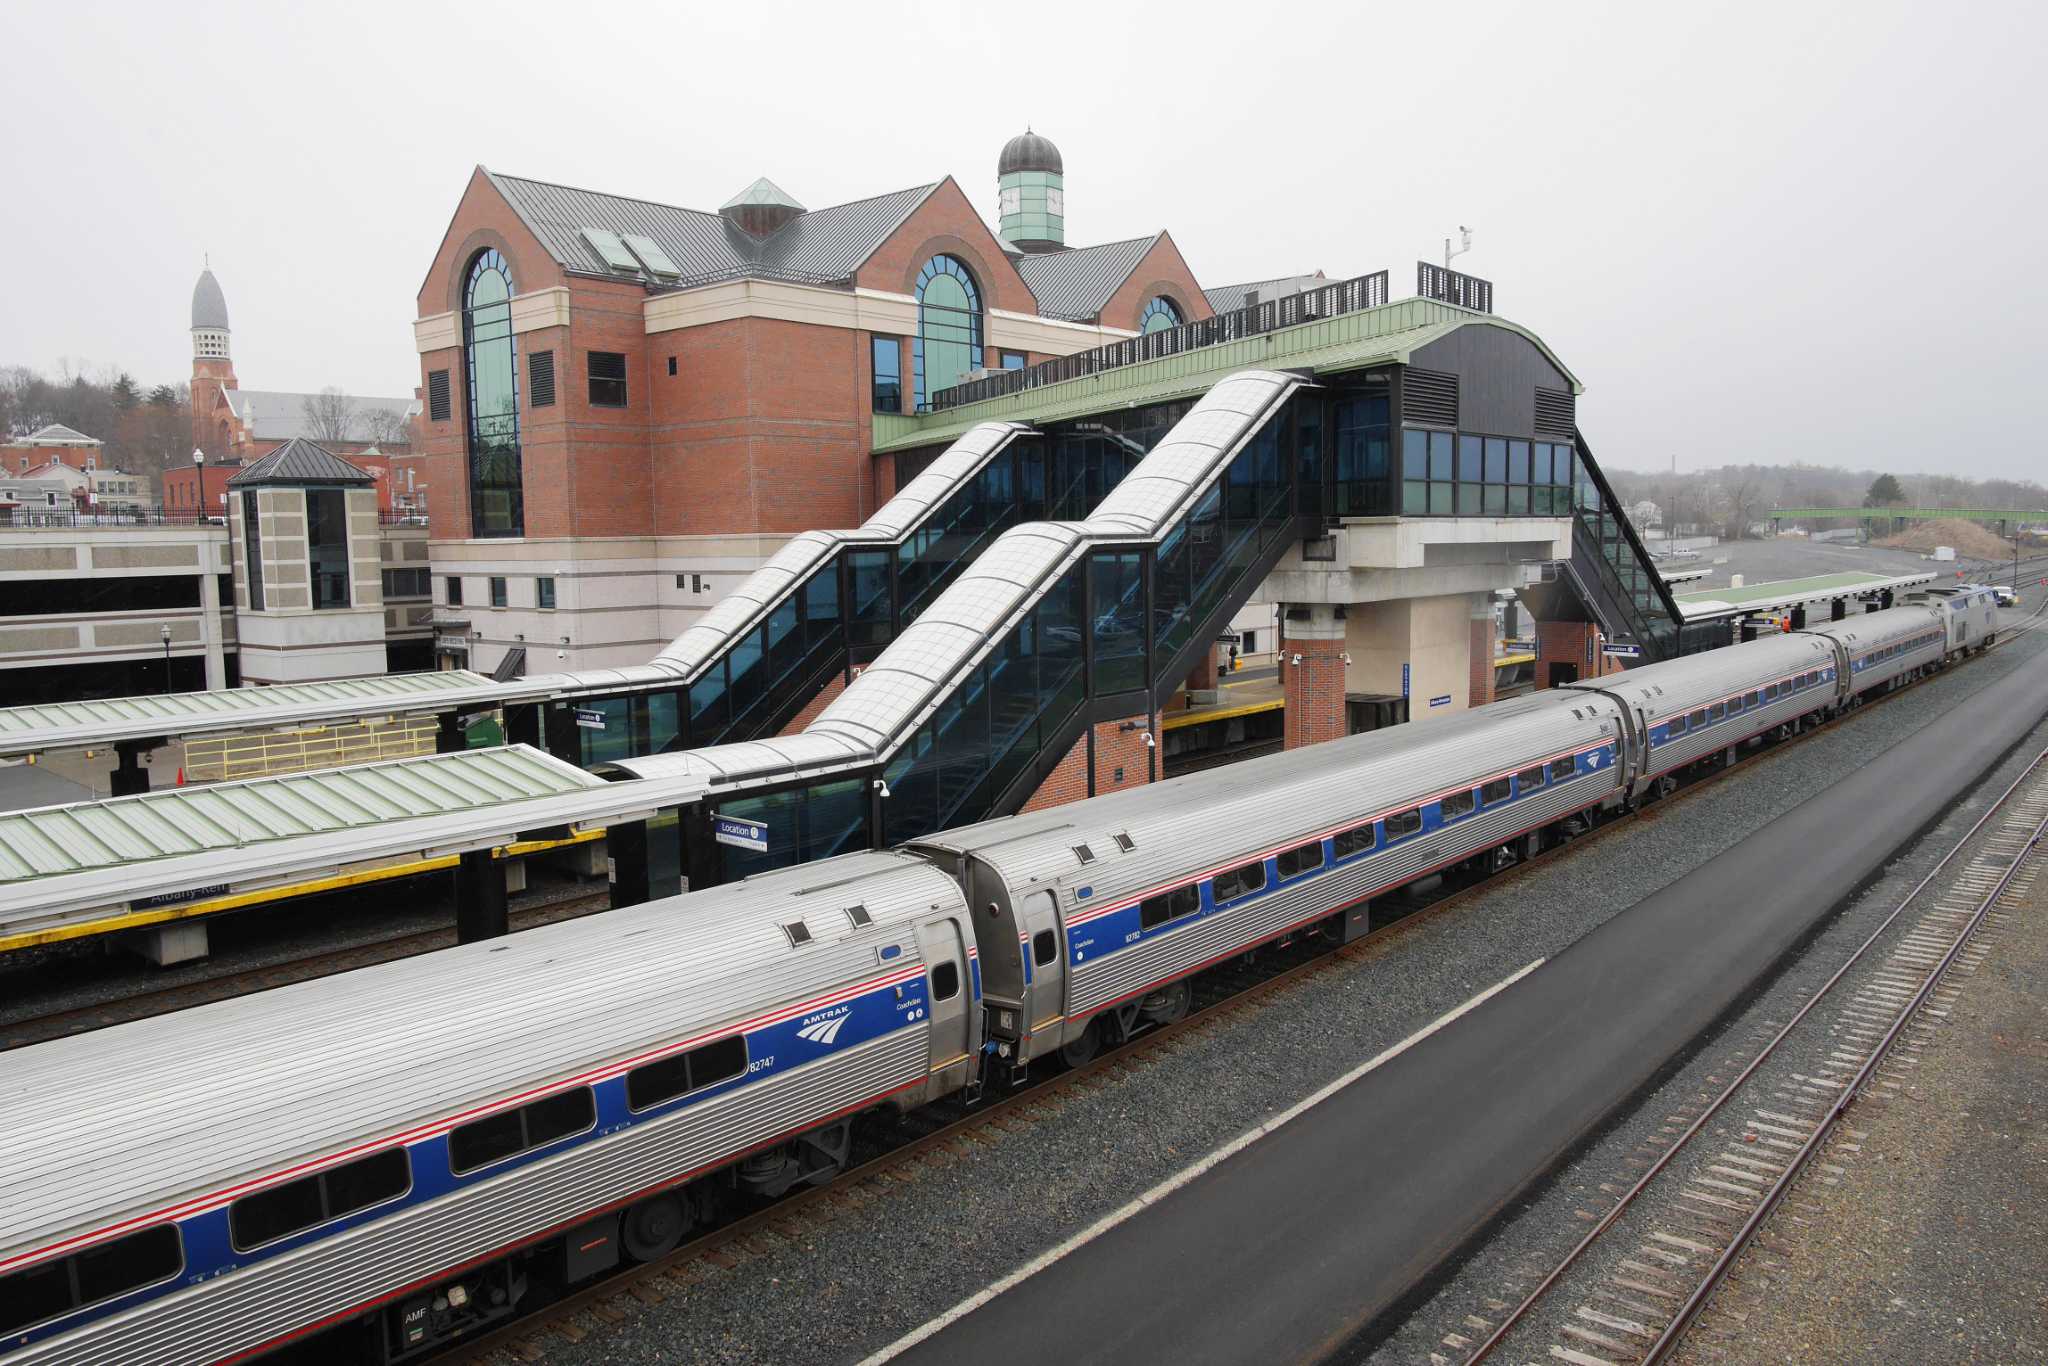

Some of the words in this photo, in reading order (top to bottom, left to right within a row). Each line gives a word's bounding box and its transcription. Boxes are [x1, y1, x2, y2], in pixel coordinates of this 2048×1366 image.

[721, 822, 749, 836] Location
[802, 1006, 849, 1026] AMTRAK
[750, 1055, 775, 1073] 82747
[405, 1307, 427, 1324] AMF
